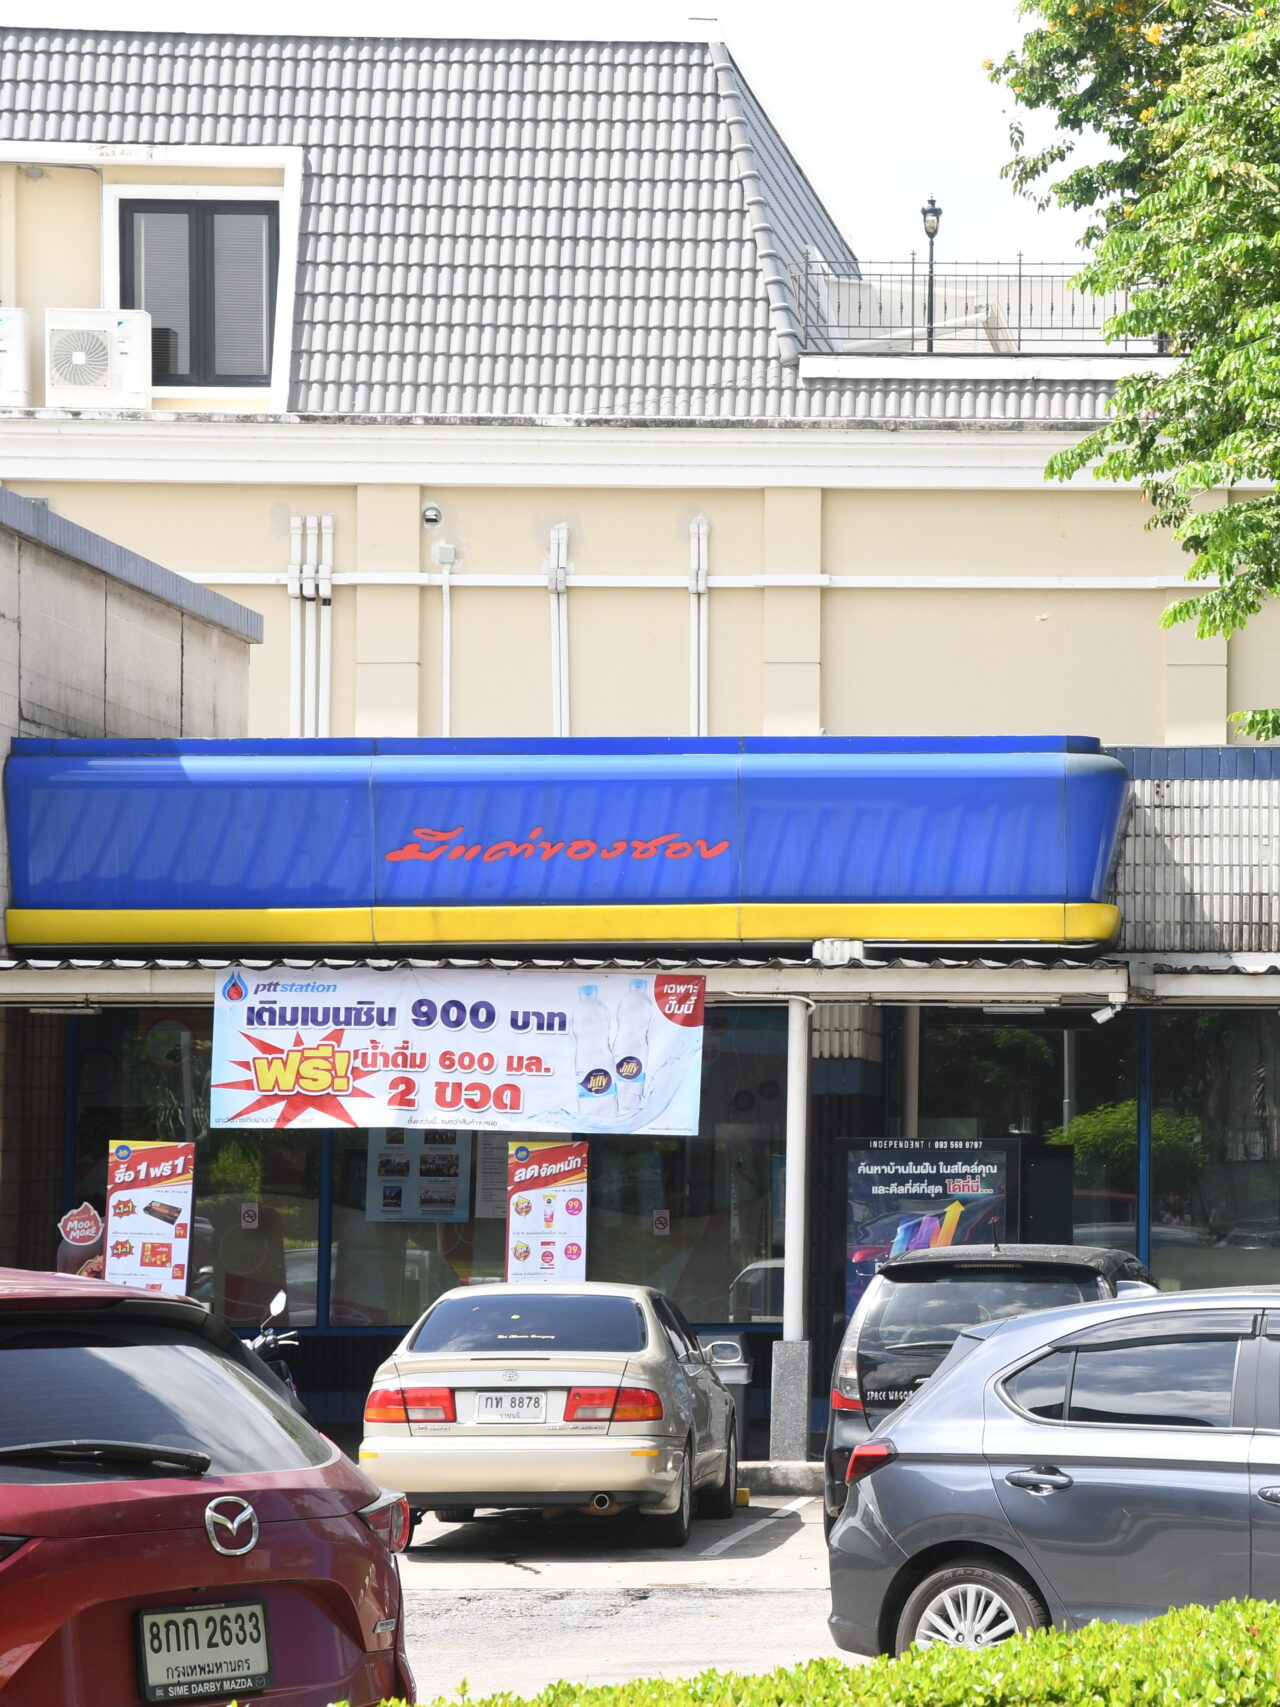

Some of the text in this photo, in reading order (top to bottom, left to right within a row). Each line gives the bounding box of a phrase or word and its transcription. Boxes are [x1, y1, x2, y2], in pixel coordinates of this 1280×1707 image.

[663, 984, 699, 994] เฉพาะ
[246, 998, 567, 1032] เติมเบนซิน 900 บาท
[253, 1044, 352, 1093] ฟรี!
[438, 1051, 496, 1072] 600
[387, 1076, 522, 1111] 2 ขวด
[114, 1156, 185, 1183] ซื้อ 1 ฟรี 1
[514, 1156, 581, 1182] ลด จัดหนัก
[510, 1396, 540, 1409] 8878
[866, 1391, 886, 1401] SPACE
[149, 1612, 261, 1654] 8กก 2633
[166, 1658, 251, 1684] กรุงเทพมหานคร
[168, 1678, 253, 1697] SIME DARBY MAZDA
